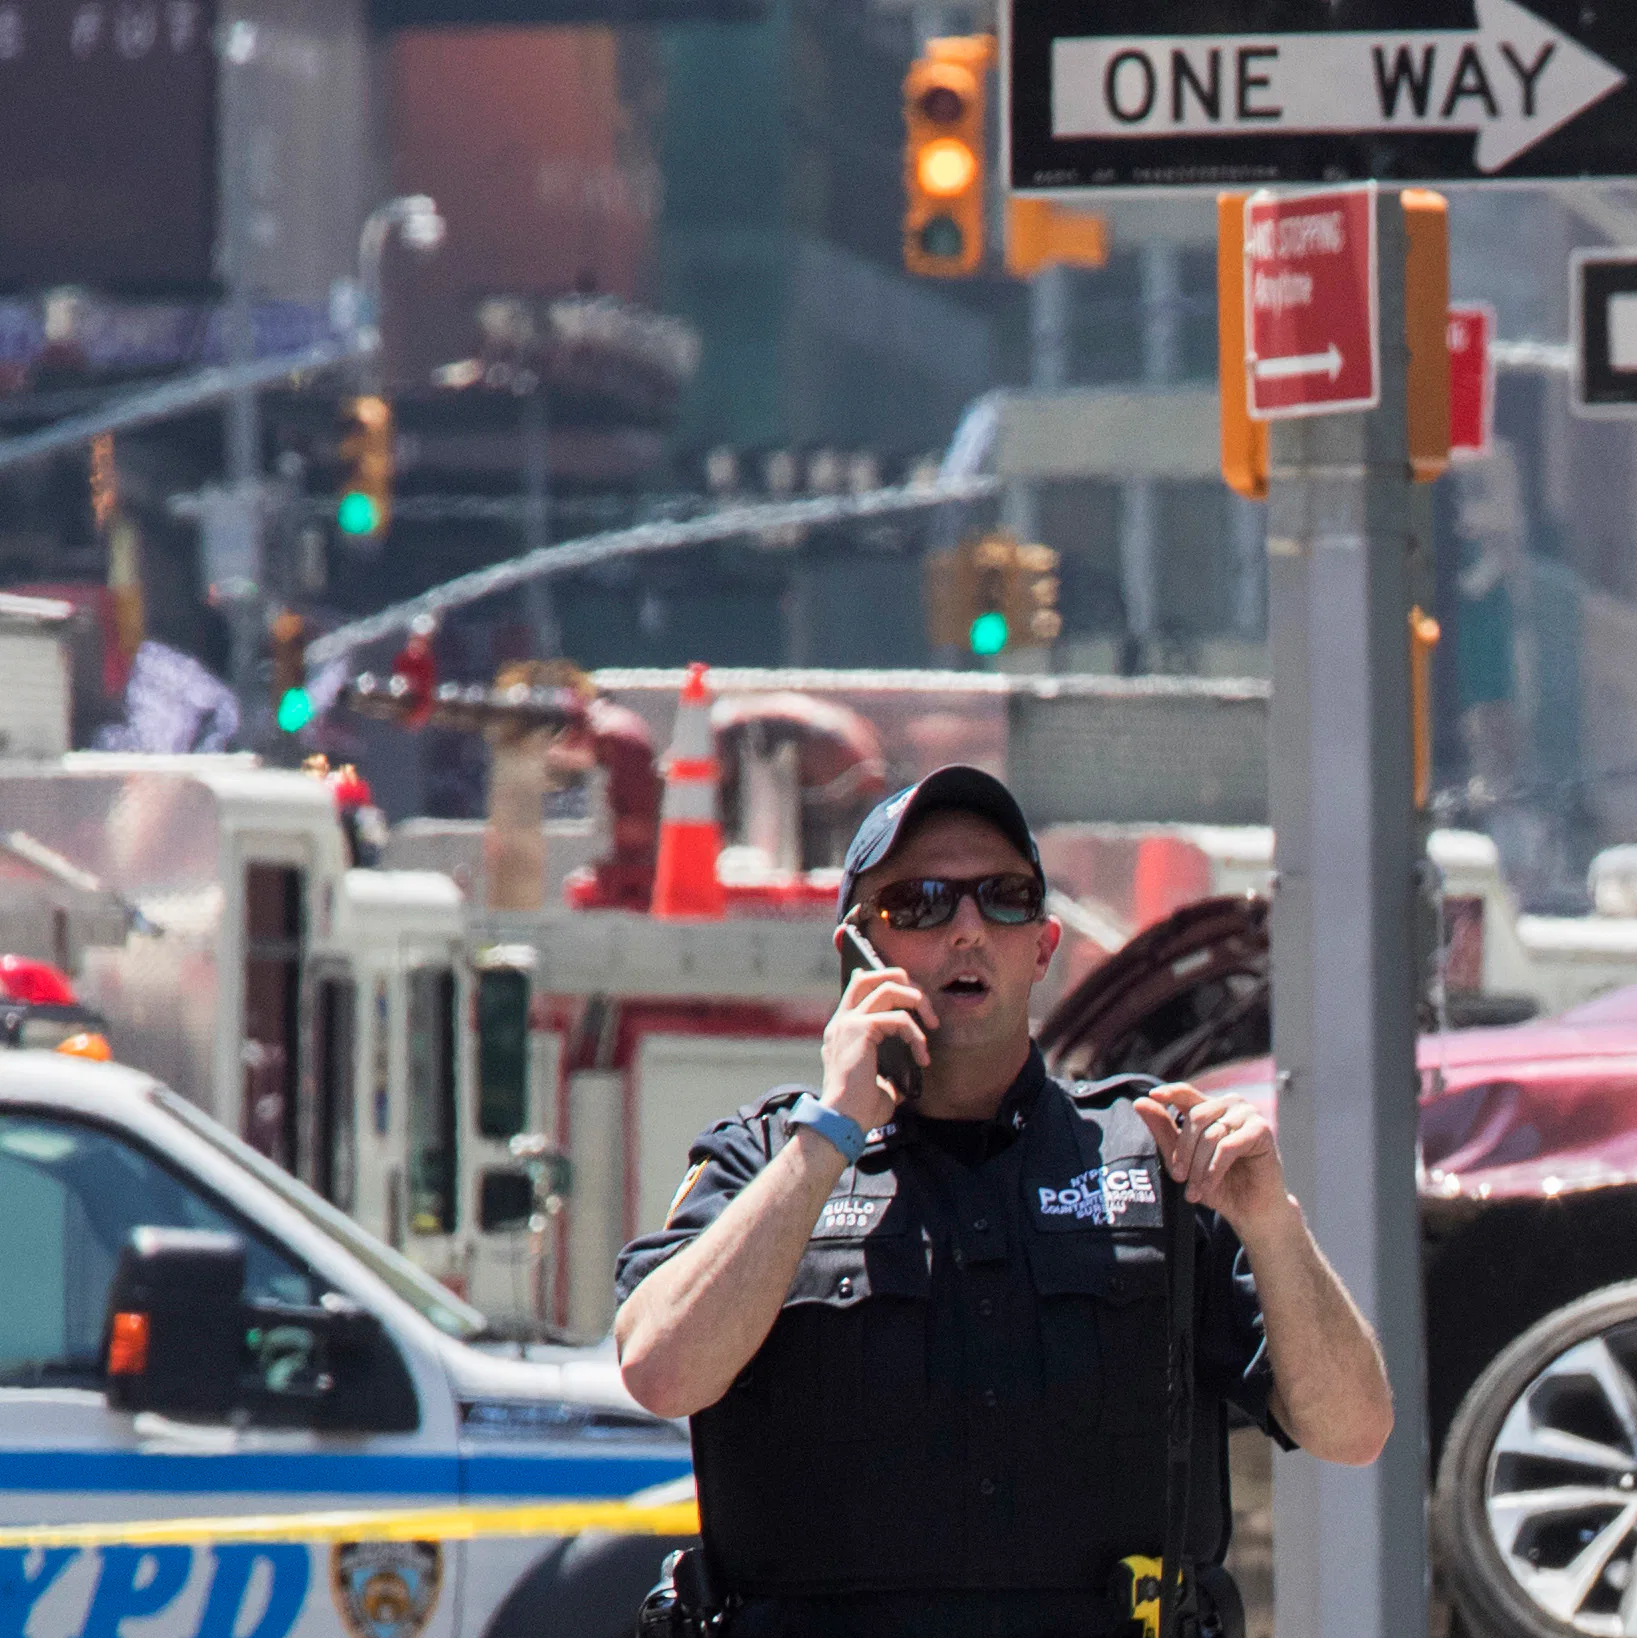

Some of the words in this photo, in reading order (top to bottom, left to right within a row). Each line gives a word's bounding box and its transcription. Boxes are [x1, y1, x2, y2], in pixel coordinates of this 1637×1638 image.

[1104, 46, 1284, 124] ONE
[1373, 41, 1558, 120] WAY
[1038, 1169, 1153, 1204] POLICE
